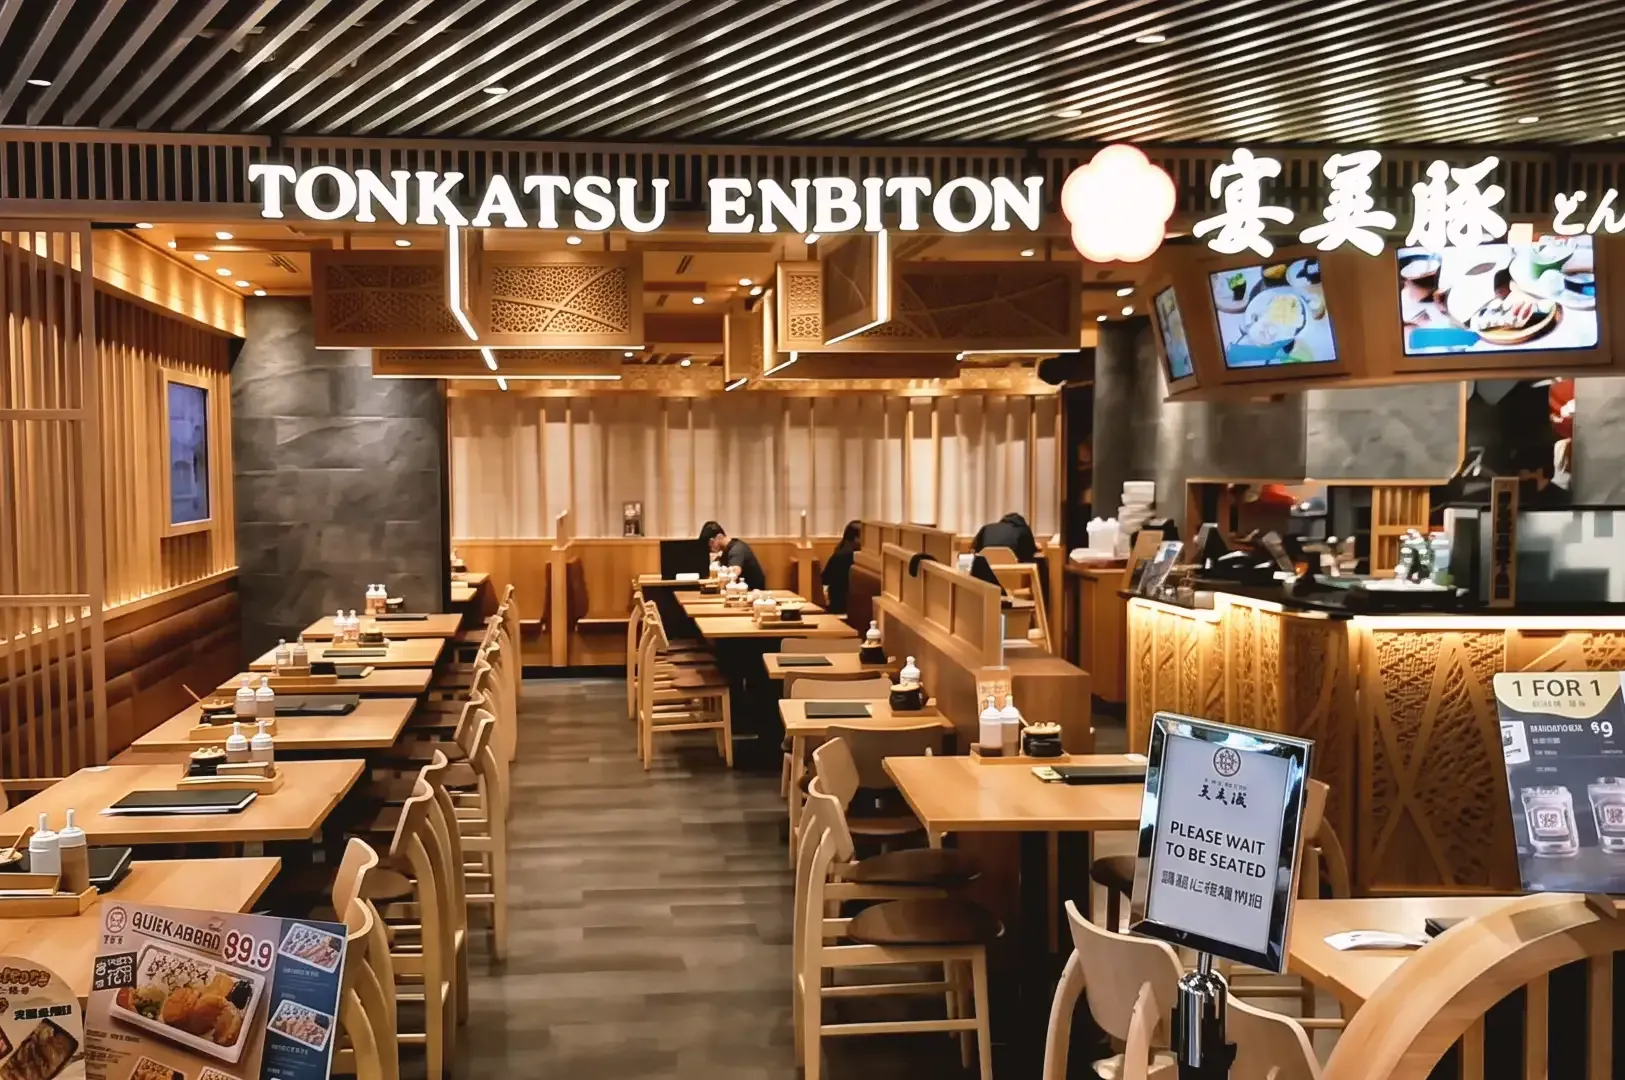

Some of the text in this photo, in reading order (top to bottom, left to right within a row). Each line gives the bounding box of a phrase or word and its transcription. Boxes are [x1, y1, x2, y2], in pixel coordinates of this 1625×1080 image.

[248, 164, 1044, 233] TONKATSU ENBITON
[1512, 679, 1601, 697] 1 FOR 1
[1170, 820, 1266, 855] PLEASE WAIT
[1165, 841, 1266, 878] TO BE SEATED
